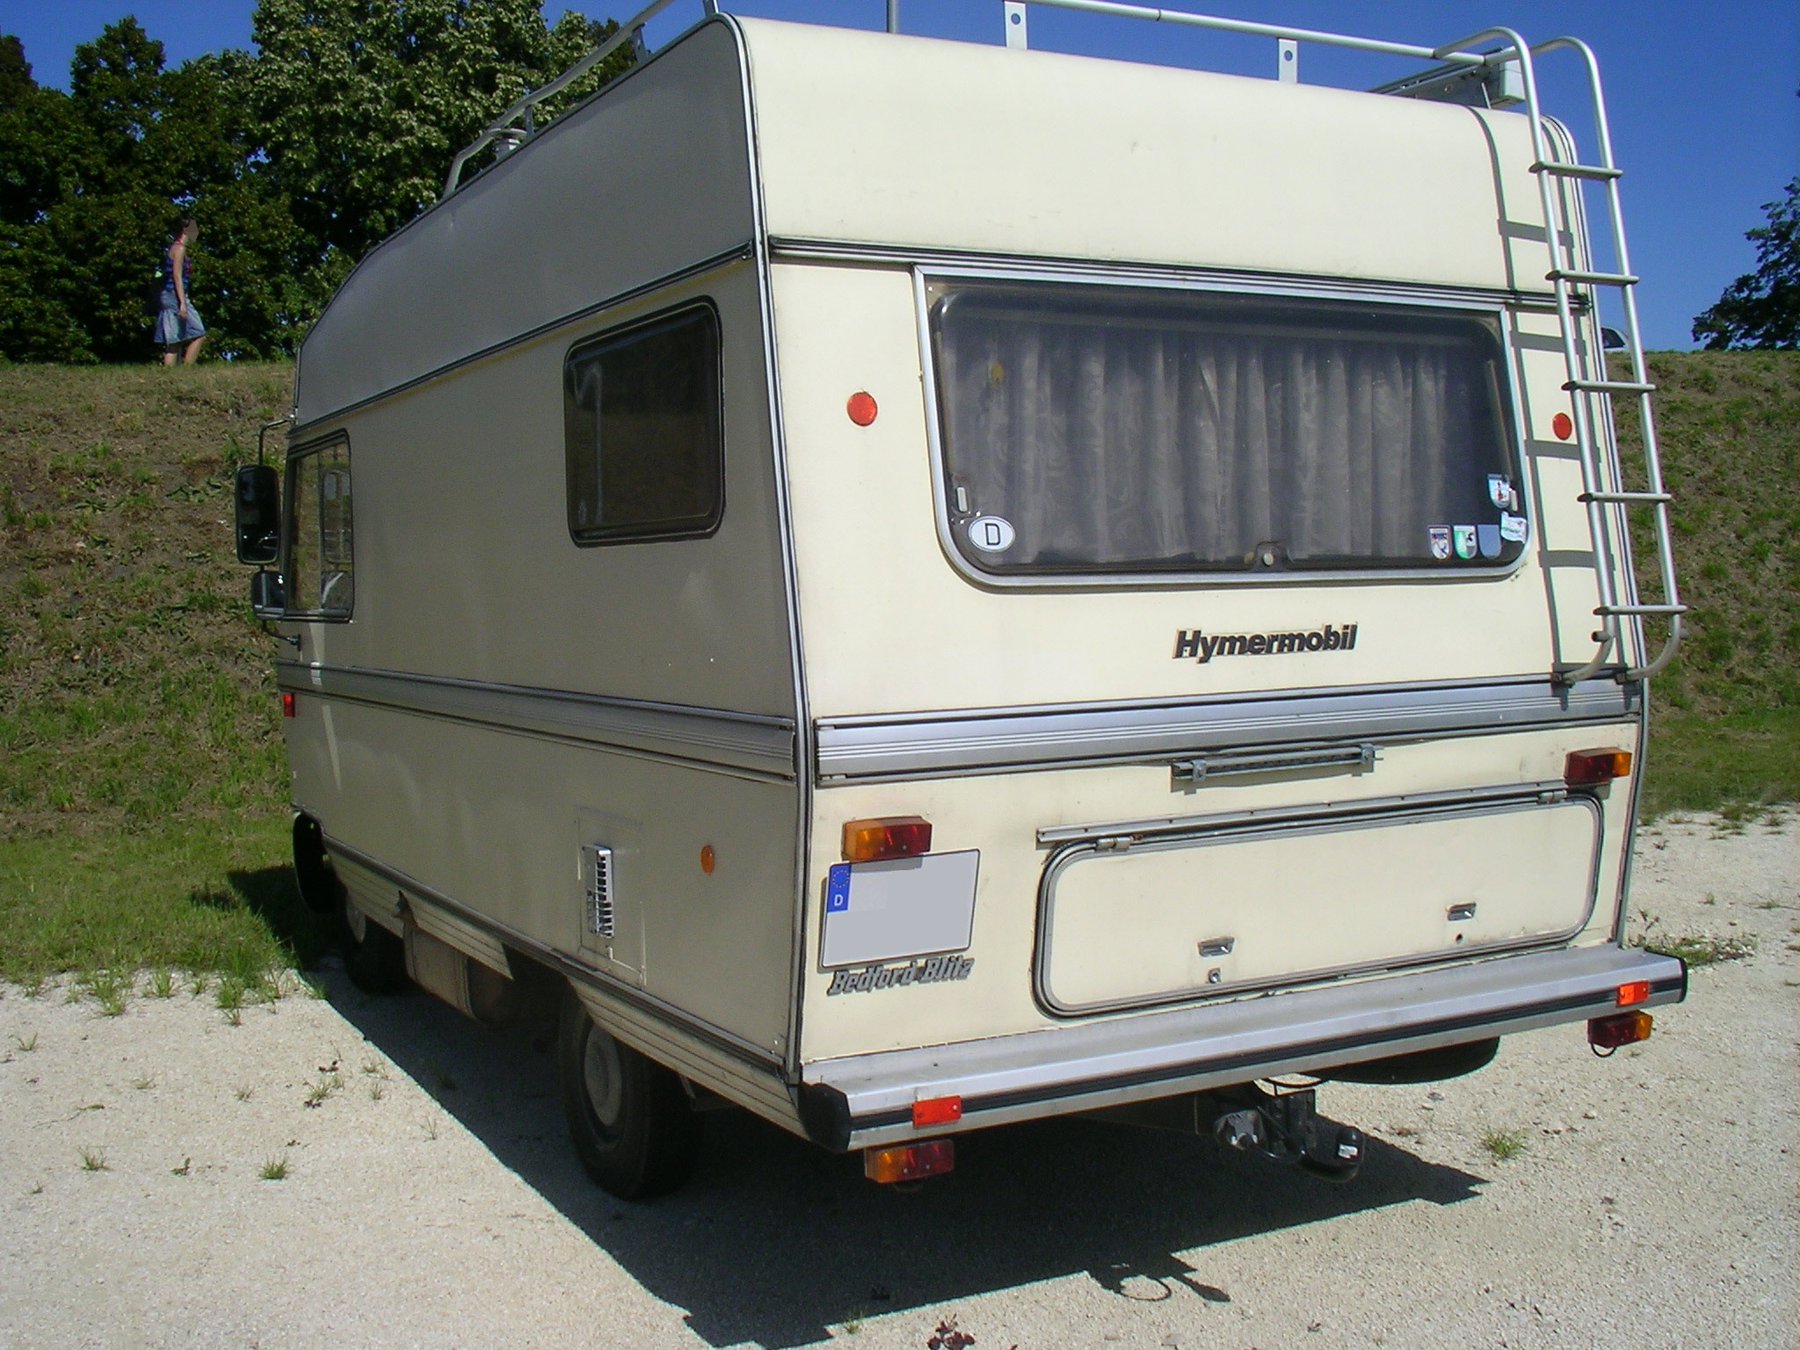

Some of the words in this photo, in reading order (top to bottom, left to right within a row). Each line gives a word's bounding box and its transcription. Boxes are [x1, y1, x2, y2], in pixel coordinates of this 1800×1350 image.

[985, 523, 1001, 546] D
[1173, 624, 1358, 664] Hymermobil
[834, 894, 844, 907] D
[827, 964, 917, 996] Bedford
[918, 955, 975, 984] Blitz
